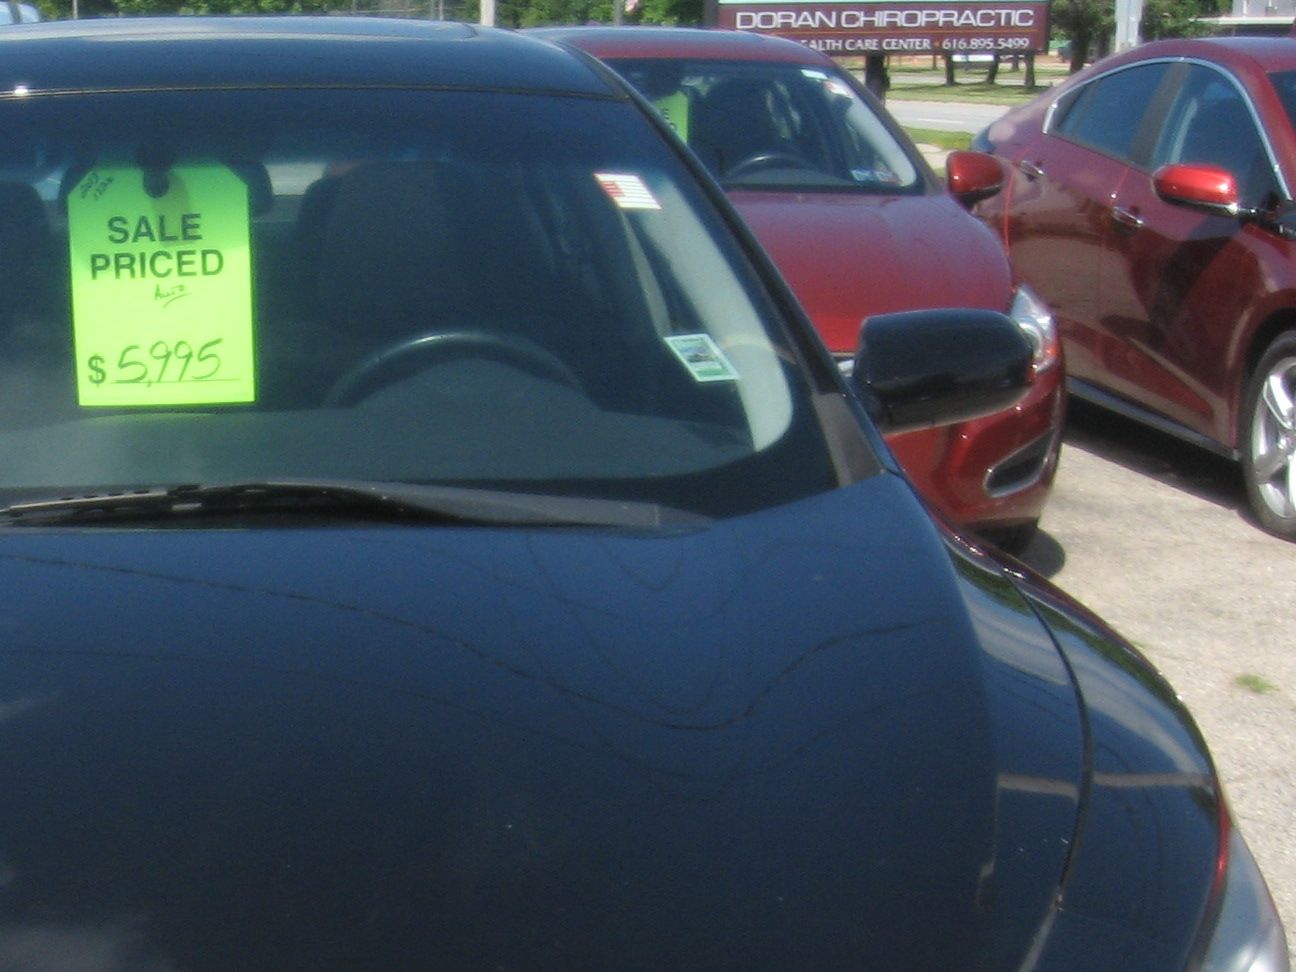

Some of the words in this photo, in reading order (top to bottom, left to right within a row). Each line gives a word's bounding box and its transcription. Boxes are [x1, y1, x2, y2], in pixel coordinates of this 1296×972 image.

[736, 11, 835, 28] DORAN
[841, 10, 1034, 27] CHIROPRACTIC
[844, 39, 879, 50] CARE
[882, 39, 931, 50] CENTER
[942, 38, 1029, 50] 616.895.5499
[107, 214, 202, 244] SALE
[91, 249, 224, 280] PRICED
[88, 353, 106, 387] $
[117, 338, 223, 387] 5,995
